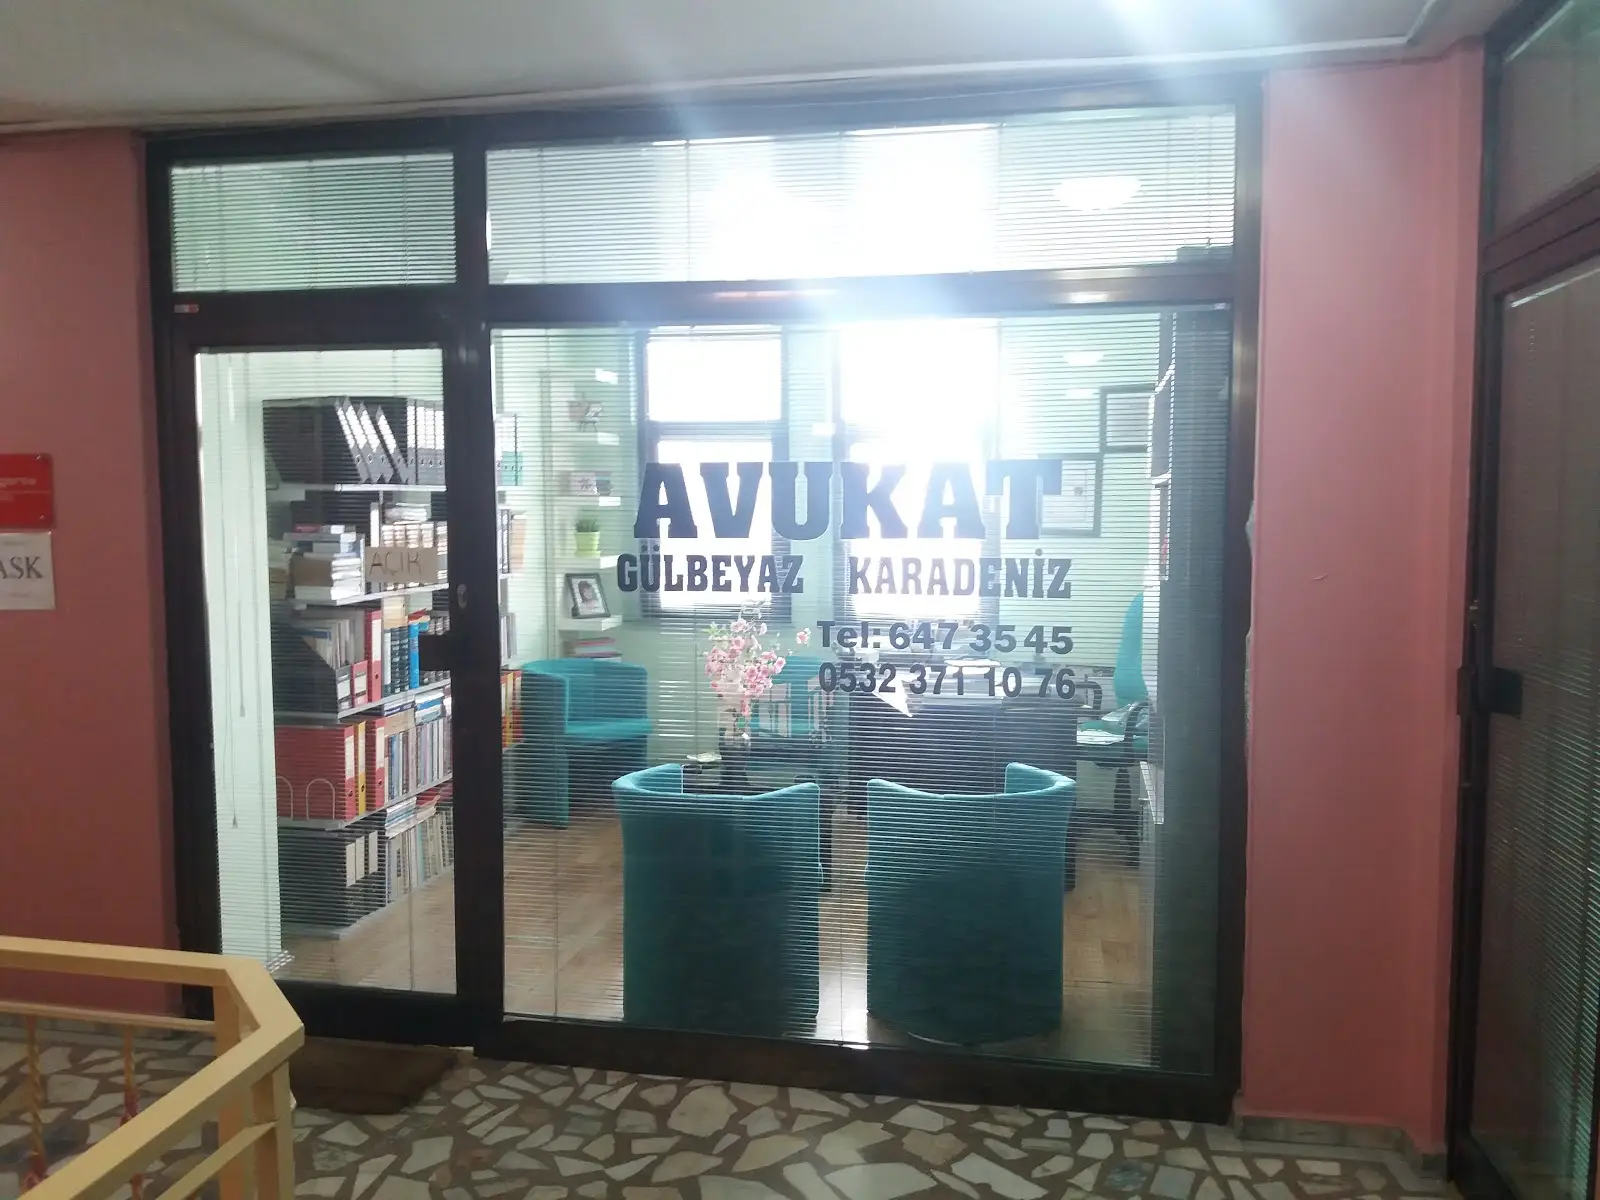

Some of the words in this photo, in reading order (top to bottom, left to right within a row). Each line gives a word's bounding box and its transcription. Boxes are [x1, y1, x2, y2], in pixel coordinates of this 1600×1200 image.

[634, 459, 1063, 541] AVUKAT
[617, 545, 804, 593] GÜLBEYAZ
[848, 548, 1072, 599] KARADENİZ
[817, 621, 881, 649] Tel:
[889, 622, 959, 650] 647
[968, 624, 1017, 653] 35
[1023, 625, 1074, 655] 45
[818, 662, 896, 693] 0532
[909, 663, 964, 696] 371
[983, 666, 1022, 697] 10
[1034, 667, 1076, 699] 76
